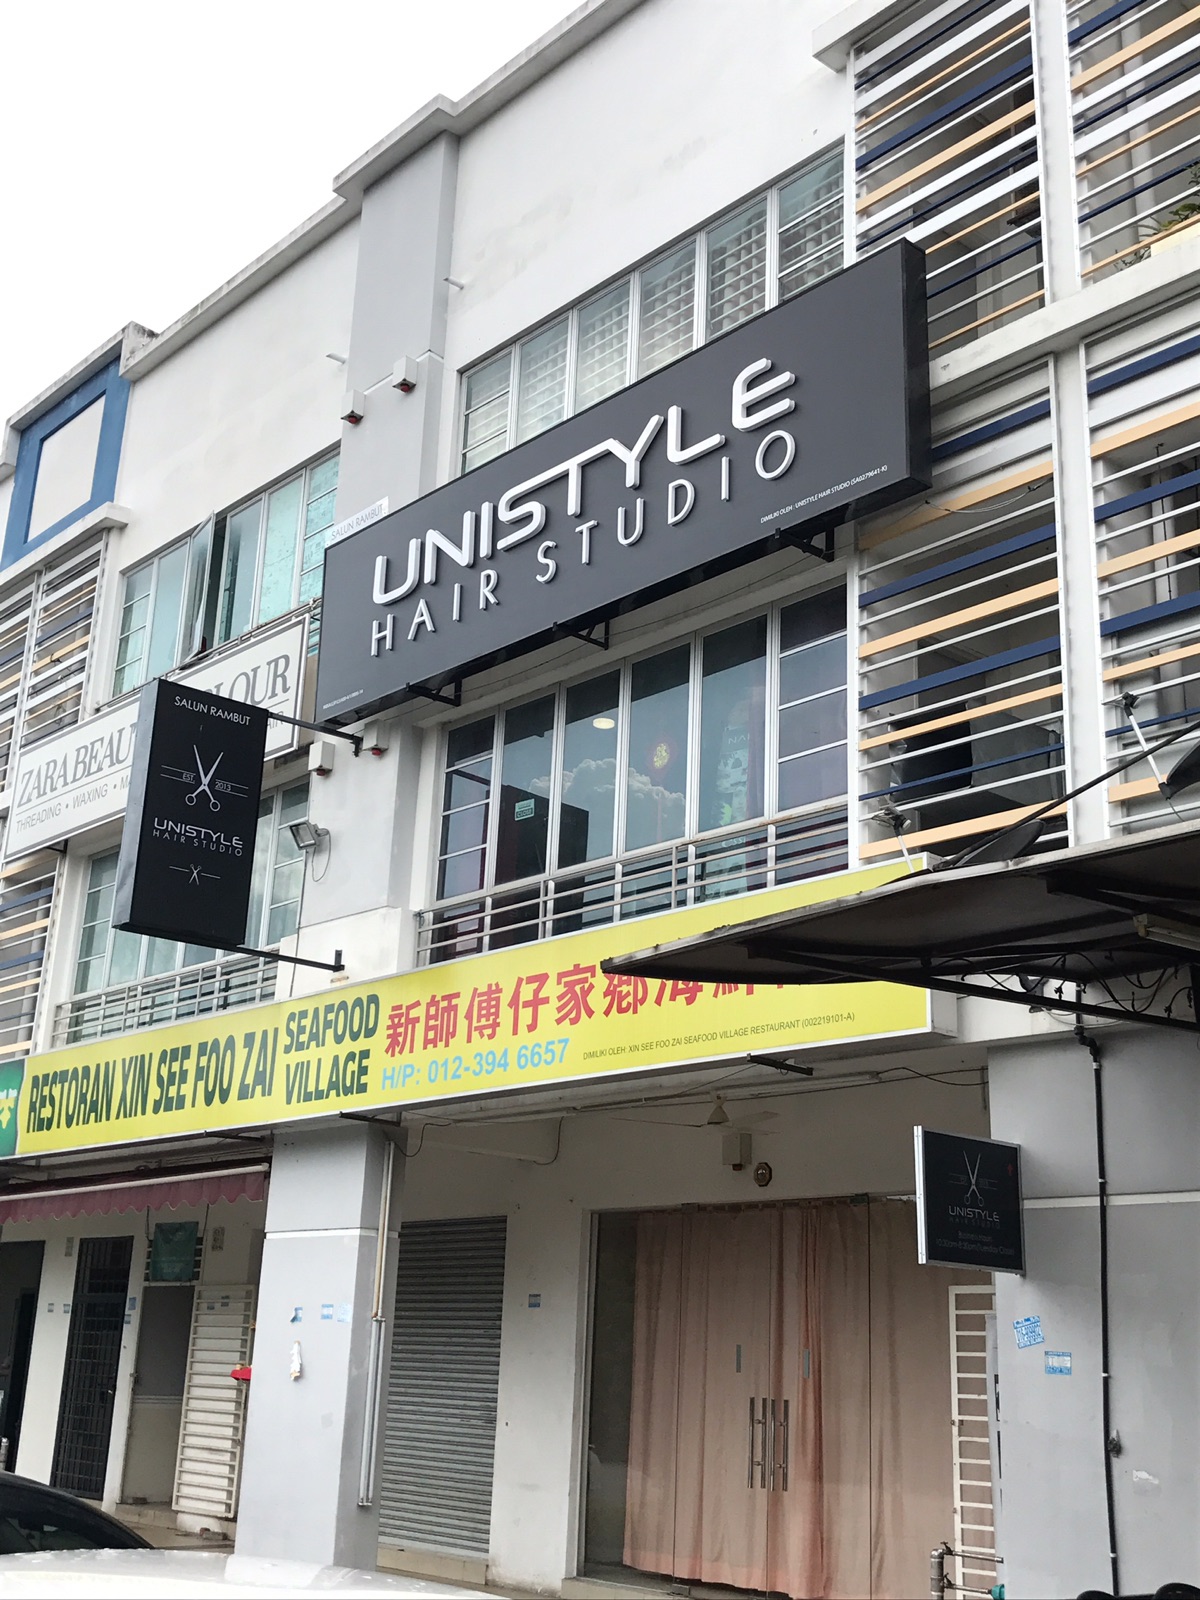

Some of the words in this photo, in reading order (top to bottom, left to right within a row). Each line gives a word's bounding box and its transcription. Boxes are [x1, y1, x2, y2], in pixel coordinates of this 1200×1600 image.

[373, 358, 796, 605] UNISTYLE
[795, 494, 819, 509] UNISTYLE
[818, 489, 831, 499] HAIR
[831, 480, 851, 494] STUDIO
[331, 521, 354, 541] SALUN
[356, 503, 383, 527] RAMBUT
[371, 569, 499, 657] HAIR
[535, 430, 796, 584] STUDIO
[174, 695, 208, 713] SALUN
[209, 706, 251, 726] RAMBUT
[17, 752, 69, 809] ZARA
[70, 724, 137, 785] BEAU
[215, 781, 231, 792] 2013
[16, 802, 62, 834] THREADING
[72, 783, 108, 809] WAXING
[154, 817, 243, 848] UNISTYLE
[152, 829, 186, 844] HAIR
[193, 838, 242, 857] STUDIO
[283, 993, 380, 1054] SEAFOOD
[583, 1048, 607, 1060] DIMILIKI
[628, 1044, 640, 1053] XIN
[641, 1041, 654, 1052] SEE
[655, 1039, 670, 1050] FOO
[671, 1036, 683, 1047] ZAI
[683, 1031, 718, 1045] SEAFOOD
[718, 1027, 749, 1040] VILLAGE
[750, 1019, 801, 1035] RESTAURANT
[801, 1012, 855, 1029] (002219101-A)
[26, 1060, 117, 1134] RESTORAN
[115, 1052, 153, 1120] XIN
[152, 1044, 192, 1115] SEE
[191, 1034, 236, 1108] FOO
[237, 1027, 279, 1101] ZAI
[285, 1048, 371, 1105] VILLAGE
[381, 1063, 421, 1091] H/P:
[427, 1047, 509, 1084] 012-394
[516, 1037, 570, 1070] 6657
[948, 1205, 1000, 1222] UNISTYLE
